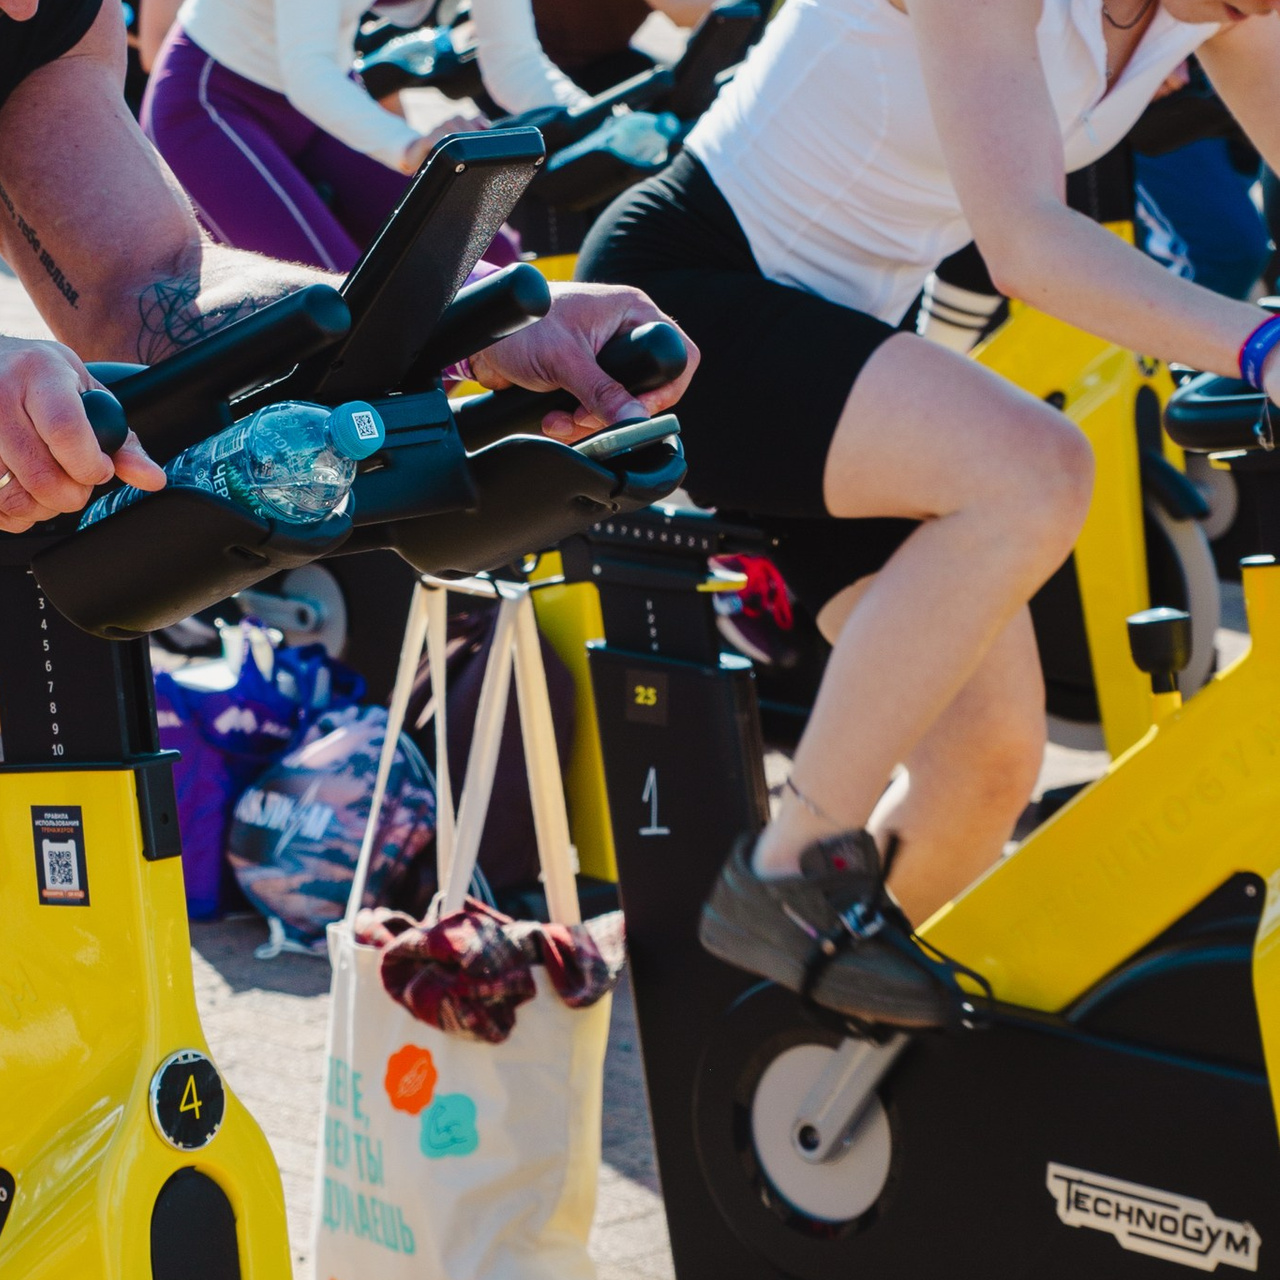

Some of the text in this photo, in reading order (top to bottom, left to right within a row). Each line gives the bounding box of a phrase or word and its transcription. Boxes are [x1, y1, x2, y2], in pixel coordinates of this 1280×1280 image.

[212, 464, 231, 501] ЧЕР
[38, 598, 46, 609] 3
[40, 619, 48, 630] 4
[43, 639, 50, 651] 5
[45, 660, 52, 672] 6
[47, 681, 54, 693] 7
[634, 685, 657, 706] 25
[49, 702, 57, 714] 8
[52, 723, 59, 735] 9
[52, 744, 64, 756] 10
[638, 766, 670, 835] 1
[44, 812, 69, 820] ПРАВИЛА
[180, 1074, 202, 1119] 4
